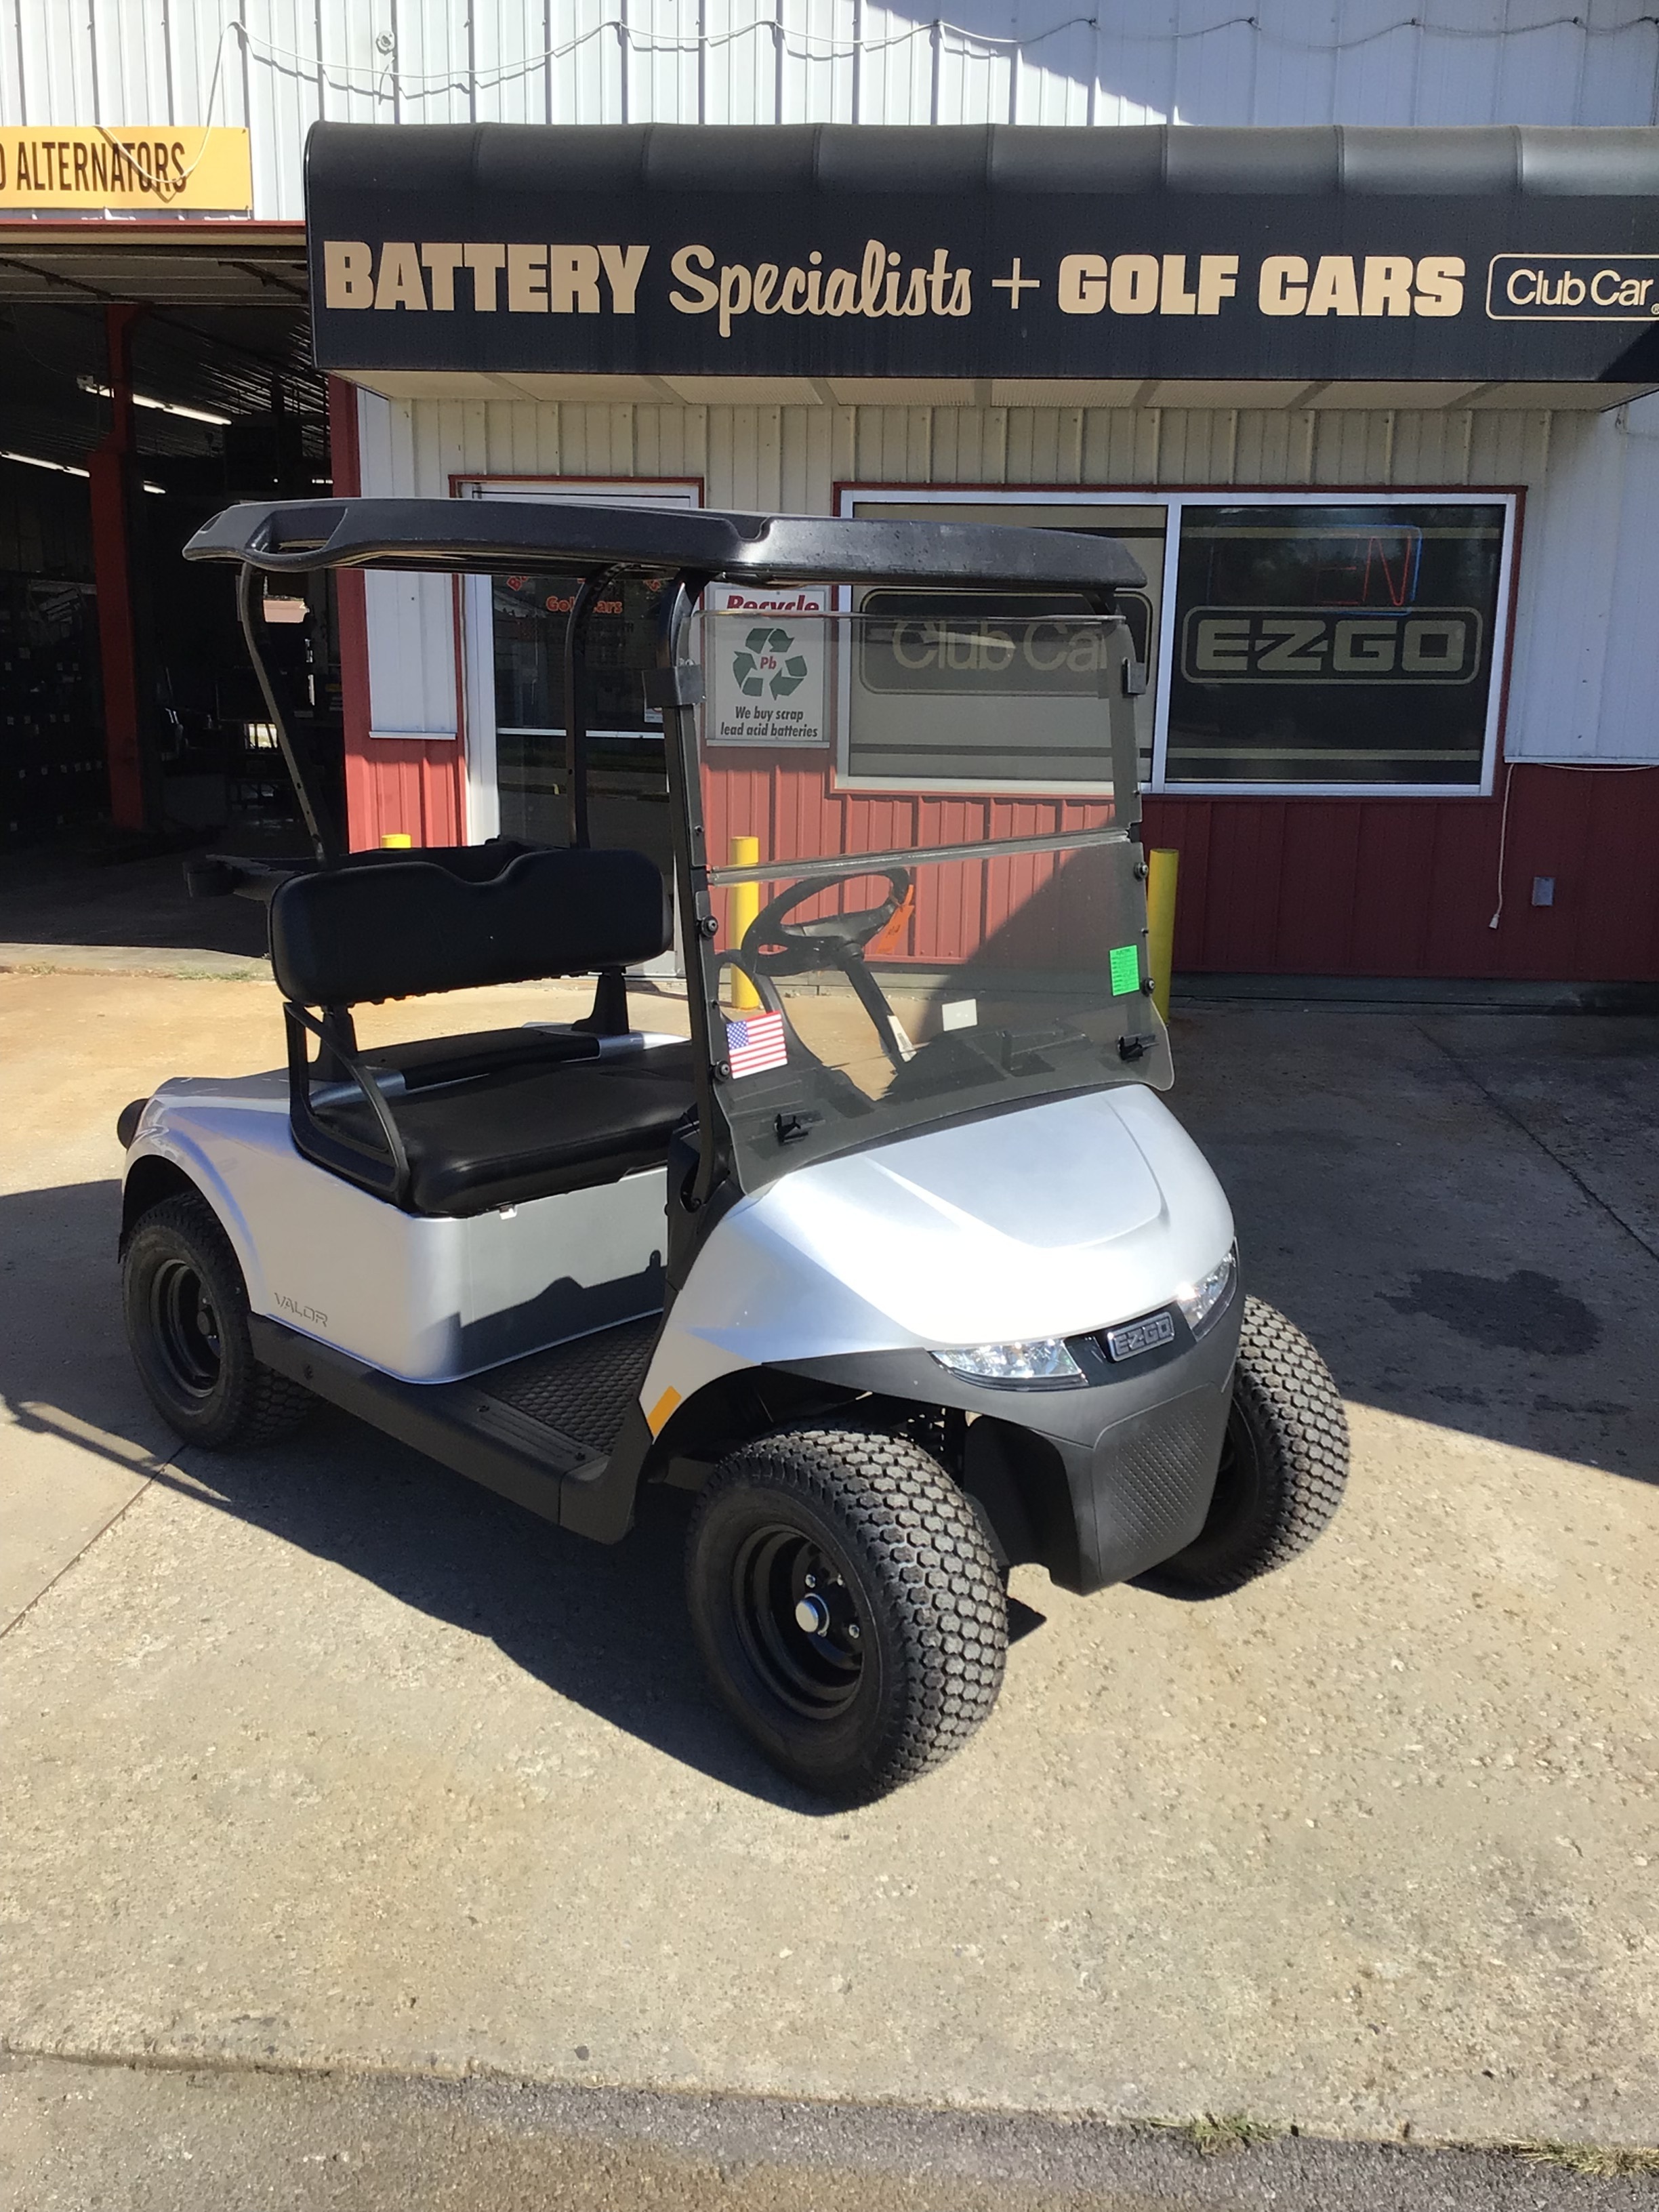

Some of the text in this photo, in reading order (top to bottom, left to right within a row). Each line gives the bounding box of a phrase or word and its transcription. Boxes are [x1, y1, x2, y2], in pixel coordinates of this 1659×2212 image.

[17, 142, 187, 192] ALTERNATORS
[324, 241, 651, 314] BATTERY
[669, 239, 971, 337] Specialists
[1058, 254, 1239, 315] GOLF
[1258, 255, 1466, 317] CARS
[1507, 268, 1654, 306] Club Car
[760, 655, 777, 670] Pb
[892, 619, 1015, 671] Club
[720, 722, 818, 737] lead acid batteries
[735, 705, 804, 723] We buy scrap
[274, 1292, 328, 1328] VALOR
